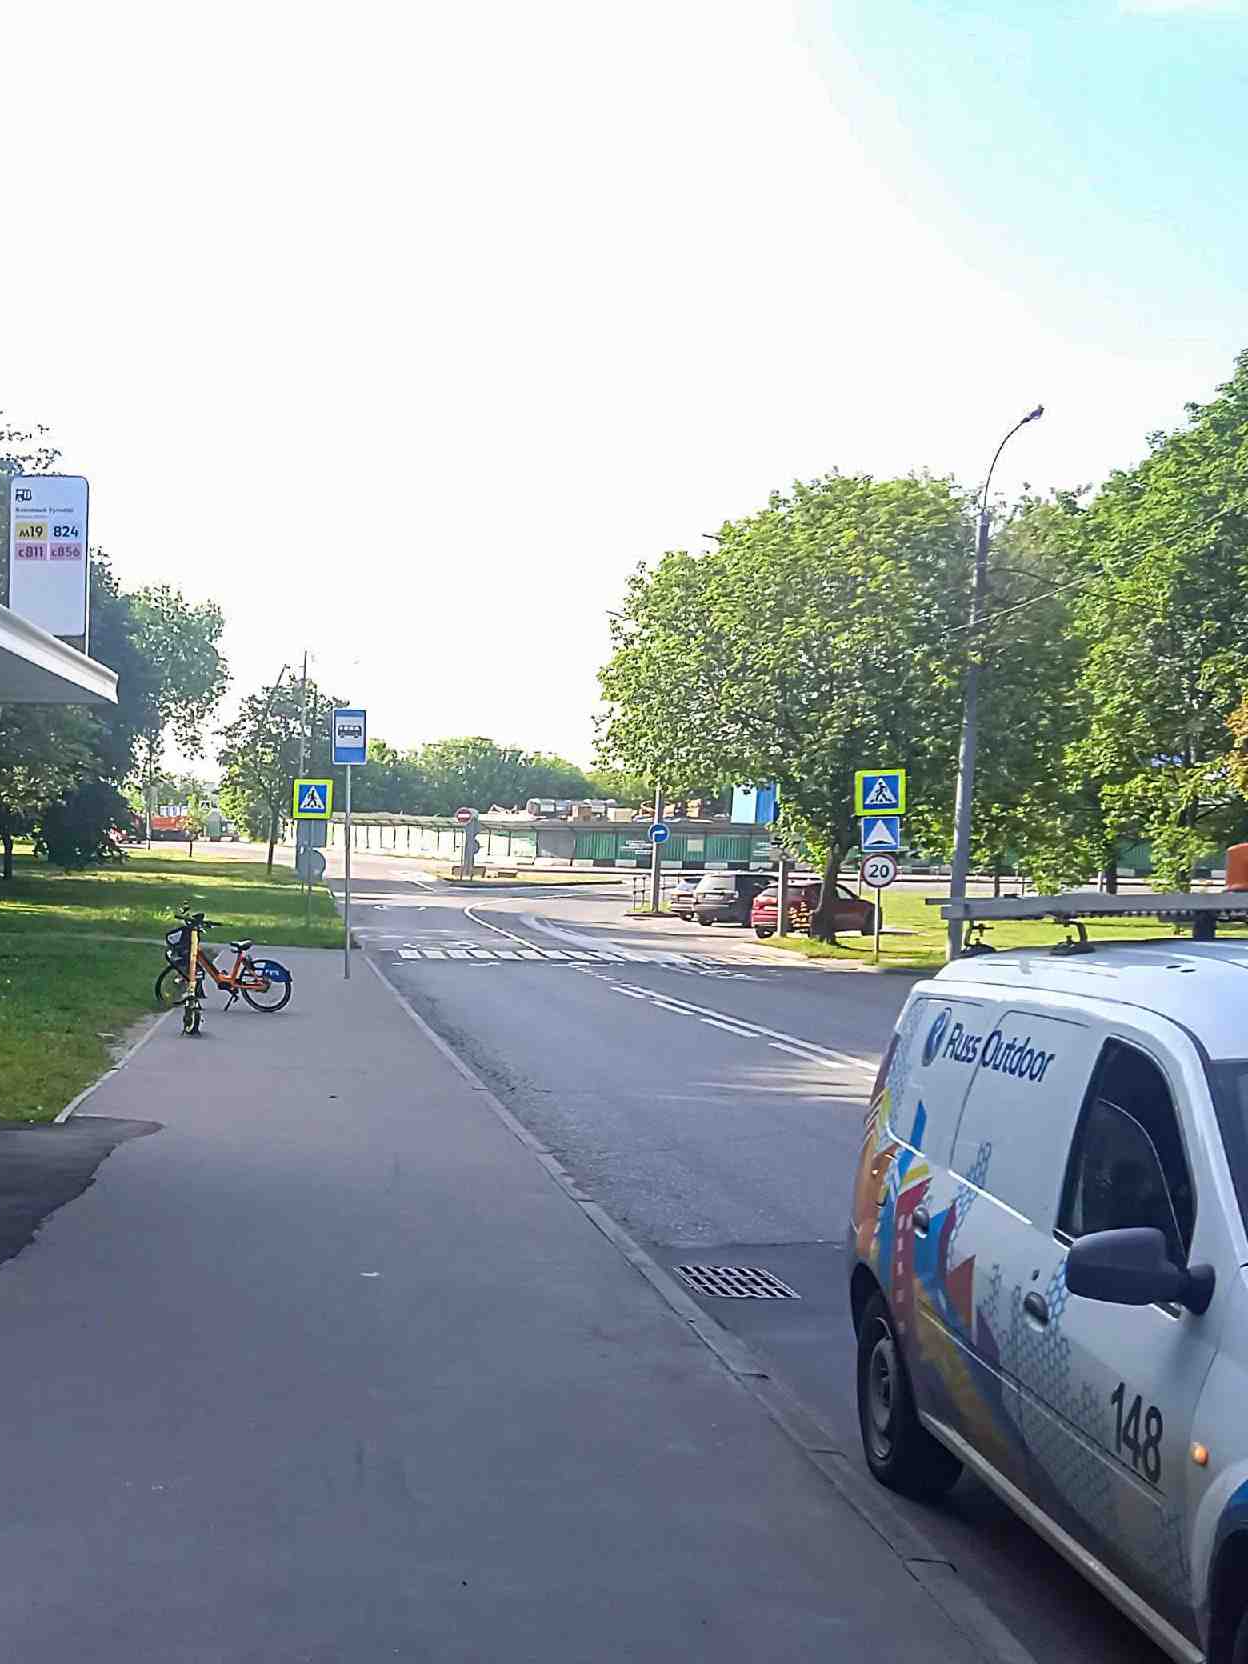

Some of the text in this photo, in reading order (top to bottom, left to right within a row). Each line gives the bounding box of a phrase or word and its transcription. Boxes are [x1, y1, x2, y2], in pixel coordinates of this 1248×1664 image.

[53, 525, 80, 538] 824
[868, 864, 890, 879] 20
[942, 1022, 1056, 1083] Russ Outdoor
[1110, 1382, 1163, 1485] 148
